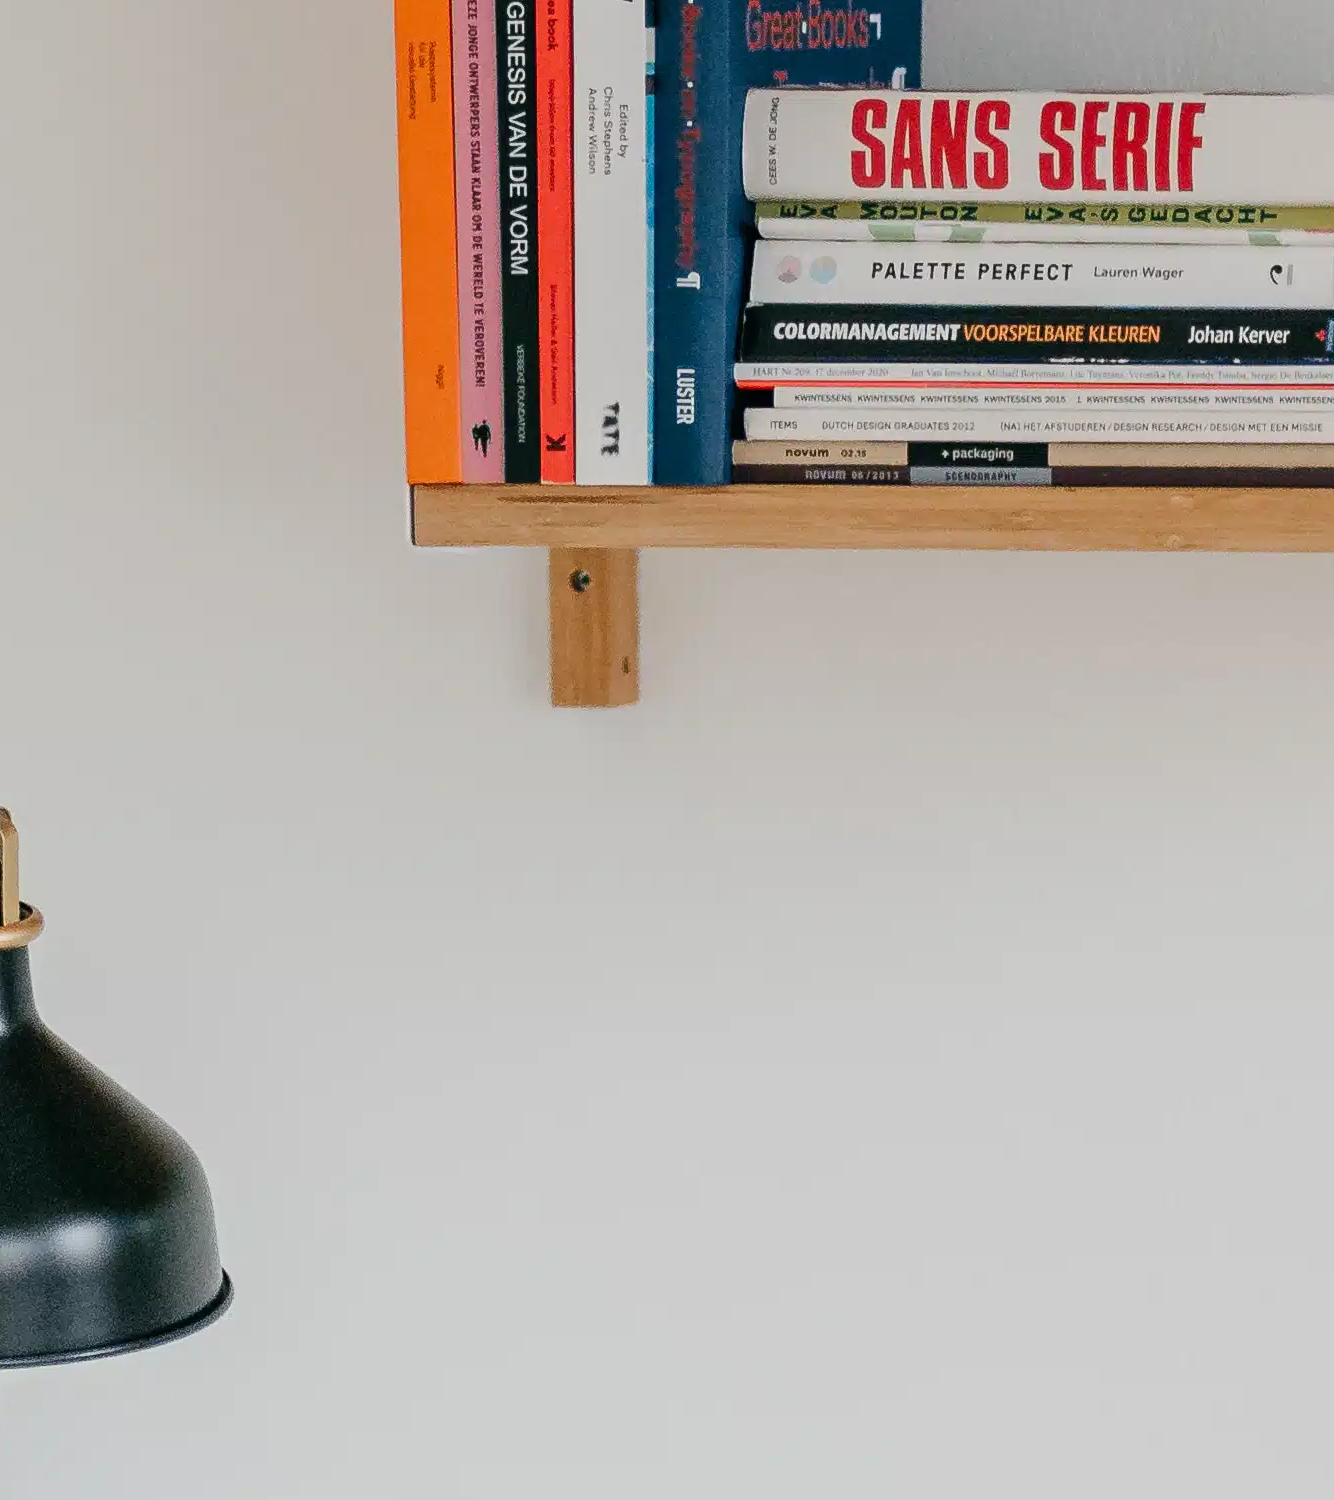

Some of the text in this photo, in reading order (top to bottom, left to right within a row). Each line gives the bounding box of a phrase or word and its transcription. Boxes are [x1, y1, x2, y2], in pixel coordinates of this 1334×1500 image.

[468, 23, 480, 60] JONGE
[547, 19, 559, 51] book
[507, 1, 526, 105] GENESIS
[468, 62, 481, 138] ONTWERPERS
[769, 96, 780, 125] JONG
[508, 112, 527, 158] VAN
[587, 87, 598, 175] Andrew Wilson
[601, 86, 614, 176] Chris Stephens
[616, 104, 629, 158] Edited by
[768, 126, 777, 141] DE
[850, 98, 1208, 193] SANS SERIF
[470, 141, 482, 174] STAAN
[768, 159, 777, 186] CEES
[471, 177, 482, 211] KLAAR
[509, 166, 527, 197] DE
[471, 214, 482, 233] OM
[779, 203, 839, 220] EVA
[1126, 205, 1278, 224] GEDACHT
[472, 235, 483, 251] DE
[509, 209, 529, 275] VORM
[472, 253, 484, 299] WERELD
[870, 261, 1185, 283] PALETTE PERFECT Lauren Wager
[473, 302, 484, 315] TE
[773, 322, 1291, 345] COLORMANAGEMENT VOORSPELBARE KLEUREN Johan Kerver
[473, 318, 485, 388] VEROVEREN!
[753, 367, 778, 377] HART
[826, 367, 866, 377] december
[516, 344, 526, 443] VERBEKE FOUNDATION
[676, 368, 696, 425] LUSTER
[795, 394, 852, 404] KWINTESSENS
[857, 394, 915, 404] KWINTESSENS
[920, 395, 979, 404] KWINTESSENS
[984, 395, 1043, 404] KWINTESSENS
[1086, 395, 1146, 405] KWINTESSENS
[1150, 395, 1210, 405] KWINTESSENS
[1214, 395, 1274, 405] KWINTESSENS
[600, 401, 620, 456] TATE
[769, 420, 798, 431] ITEMS
[821, 421, 854, 431] DUTCH
[856, 421, 892, 431] DESIGN
[894, 422, 950, 432] GRADUATES
[952, 422, 975, 432] 2012
[1023, 422, 1042, 432] HET
[1044, 422, 1106, 432] AFSTUDEREN
[1113, 423, 1149, 432] DESIGN
[1151, 423, 1202, 432] RESEARCH
[1209, 423, 1246, 432] DESIGN
[1247, 423, 1267, 432] MET
[1270, 423, 1288, 433] EEN
[1291, 423, 1323, 433] MISSIE
[785, 448, 829, 458] novum
[952, 447, 1014, 462] packaging
[805, 469, 847, 481] novum
[945, 470, 1018, 482] SCENOGRAPHY
